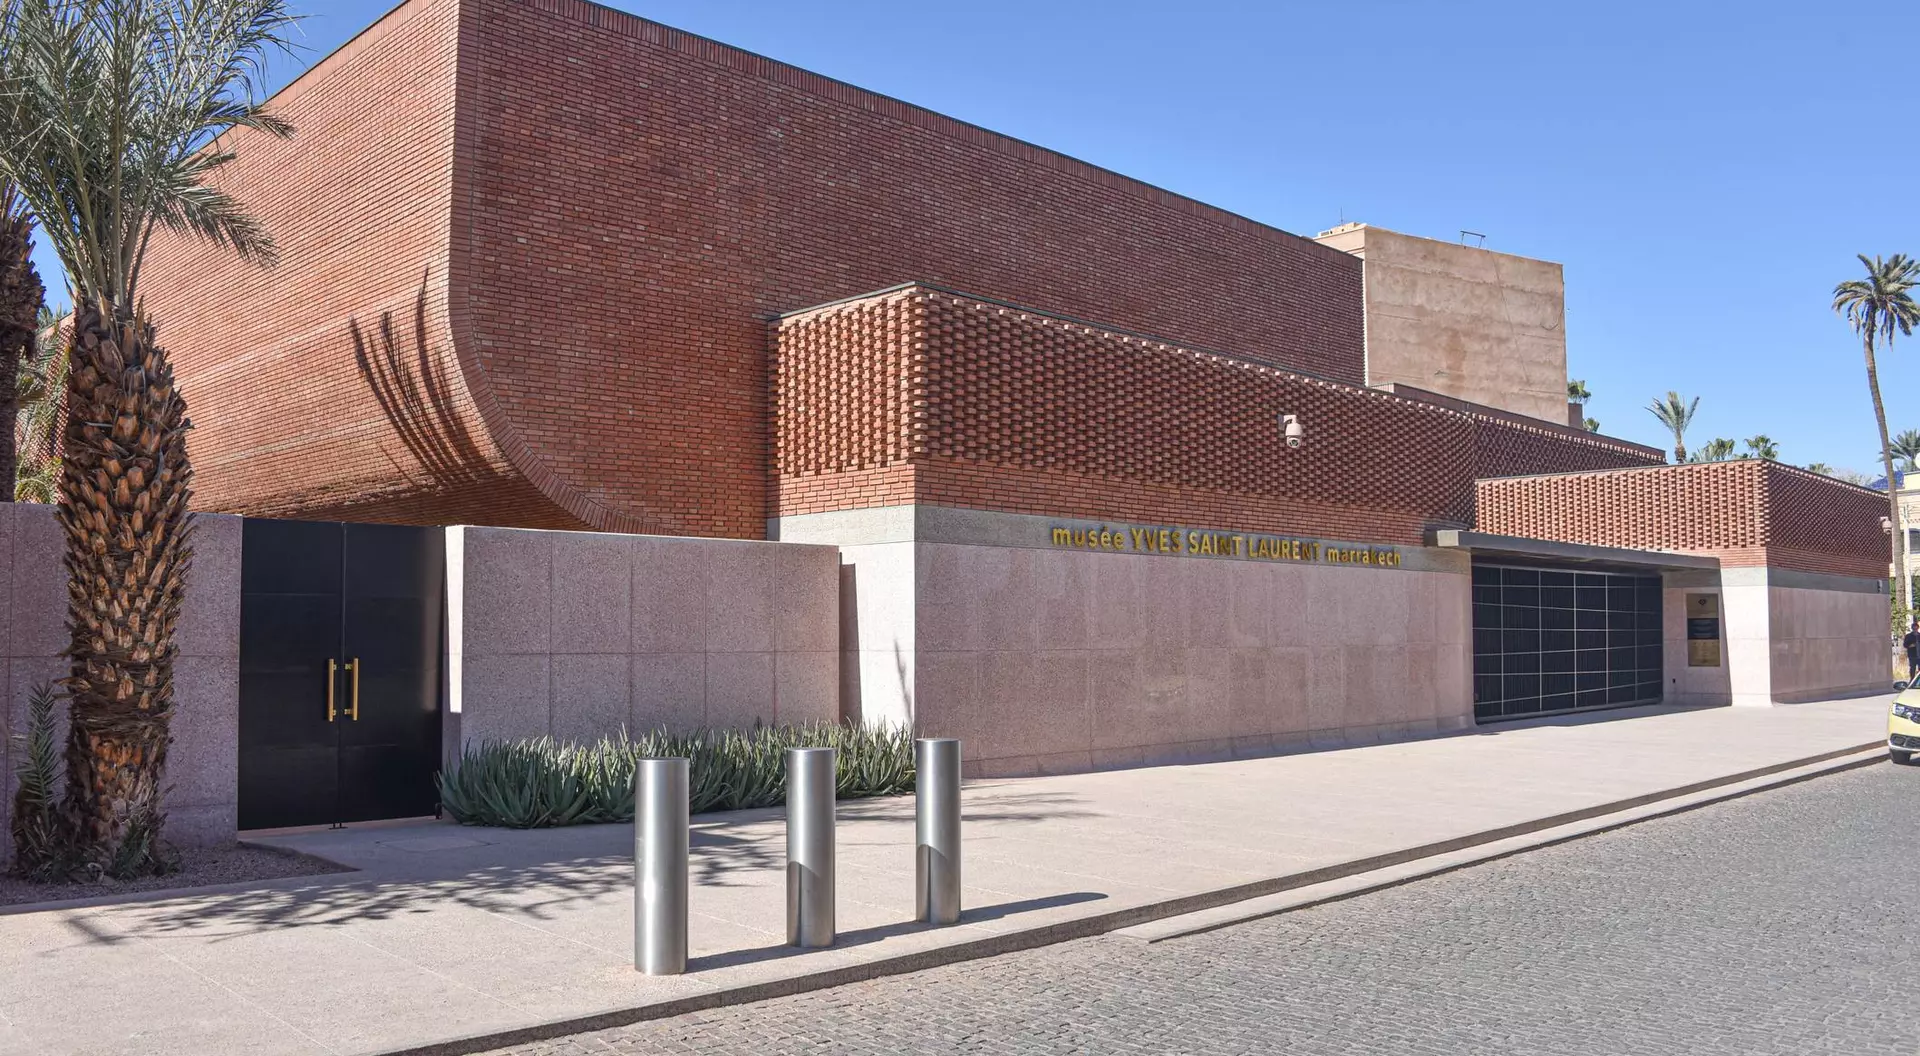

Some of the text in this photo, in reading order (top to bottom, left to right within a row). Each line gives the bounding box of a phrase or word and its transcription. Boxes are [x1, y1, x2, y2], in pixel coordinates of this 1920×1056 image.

[1052, 525, 1401, 566] musée YVES SAINT LAURENT marrakech
